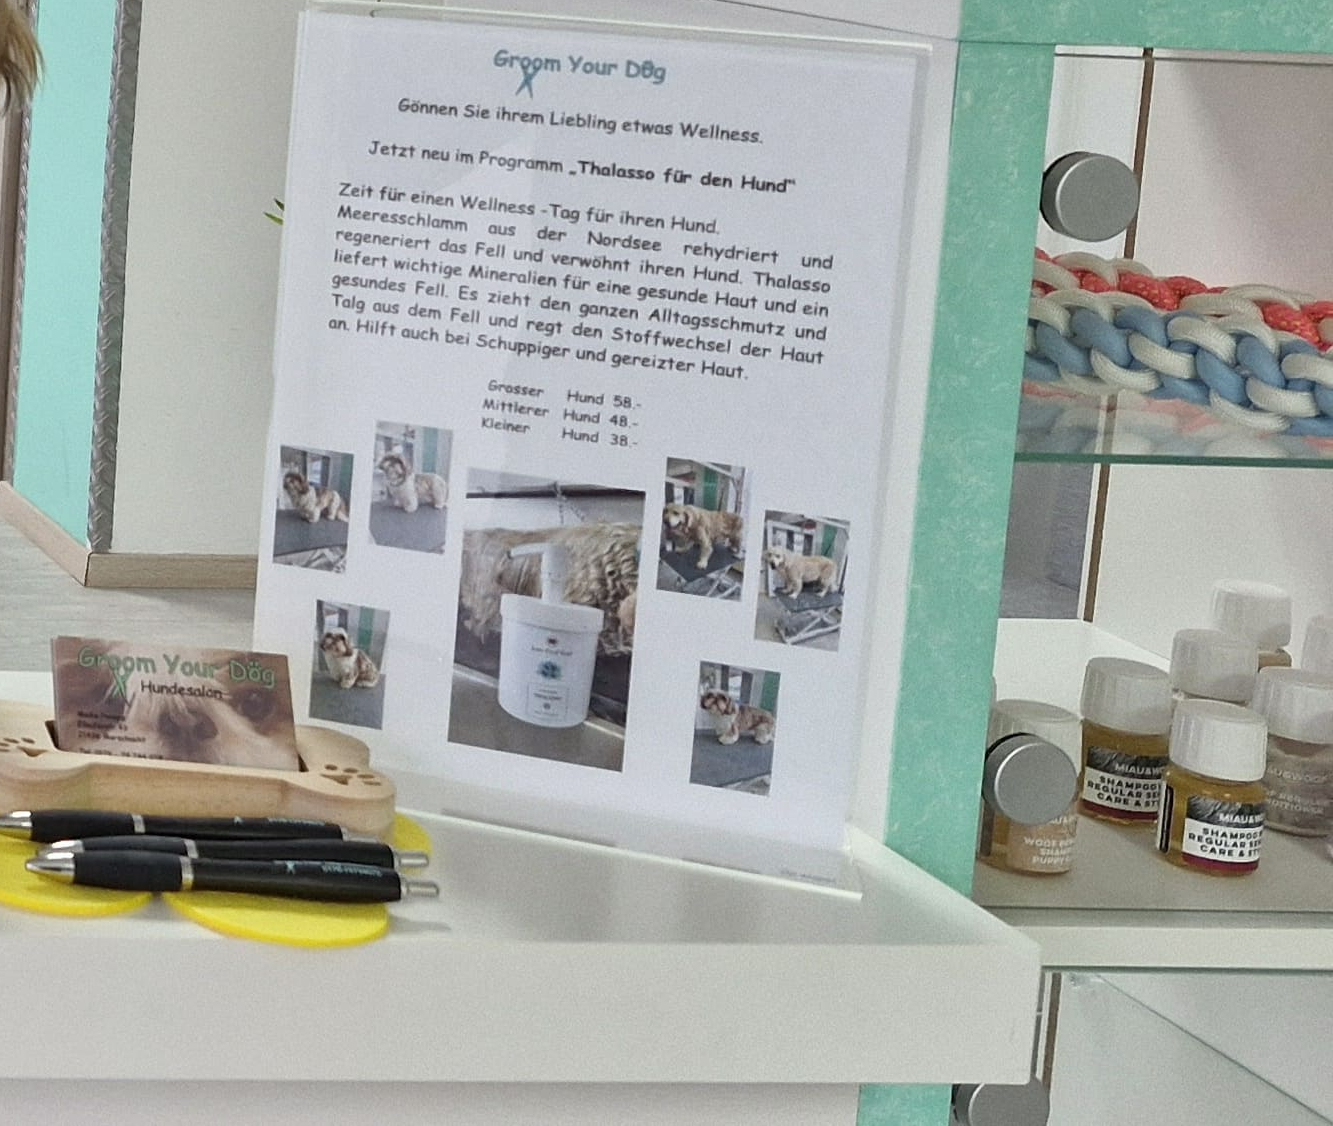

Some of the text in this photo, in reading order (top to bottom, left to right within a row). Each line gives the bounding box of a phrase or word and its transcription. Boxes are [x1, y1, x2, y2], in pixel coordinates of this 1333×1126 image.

[494, 50, 561, 78] Groom
[568, 56, 618, 75] Your
[398, 98, 763, 144] Gönnen Sie ihrem Liebling etwas Wellness.
[369, 141, 416, 158] Jetzt
[421, 149, 450, 161] neu
[455, 149, 474, 164] im
[479, 150, 563, 173] Programm
[663, 168, 692, 184] für
[700, 171, 732, 188] den
[339, 182, 373, 198] Zeit
[379, 186, 406, 202] für
[411, 191, 454, 207] einen
[461, 195, 535, 215] Wellness
[586, 207, 614, 223] für
[620, 211, 664, 229] ihren
[671, 216, 719, 234] Hund.
[337, 205, 833, 269] Meeresschlamm aus der Nordsee rehydriert und
[336, 231, 830, 293] regeneriert das Fell und verwöhnt ihren Hund. Thalasso
[334, 249, 828, 317] liefert wichtige Mineralien für eine gesunde Haut und ein
[332, 275, 827, 341] gesundes Fell. Es zieht den ganzen Alltagsschmutz und
[332, 293, 824, 364] Talg aus dem Fell und regt den Stoffwechsel der Haut
[329, 319, 748, 380] an. Hilft auch bei Schuppiger und gereizter Haut.
[488, 380, 544, 397] Grosser
[567, 390, 604, 405] Hund
[483, 399, 549, 416] Mittlerer
[563, 408, 600, 424] Hund
[481, 418, 530, 433] Kleiner
[562, 428, 599, 443] Hund
[78, 646, 156, 674] Groom
[163, 654, 218, 678] Your
[141, 680, 223, 699] Hundesalon
[1088, 781, 1142, 798] REGULAR
[1099, 776, 1157, 790] SHAMPOO
[1097, 793, 1129, 805] CARE
[1189, 833, 1246, 848] REGULAR
[1200, 845, 1233, 856] CARE
